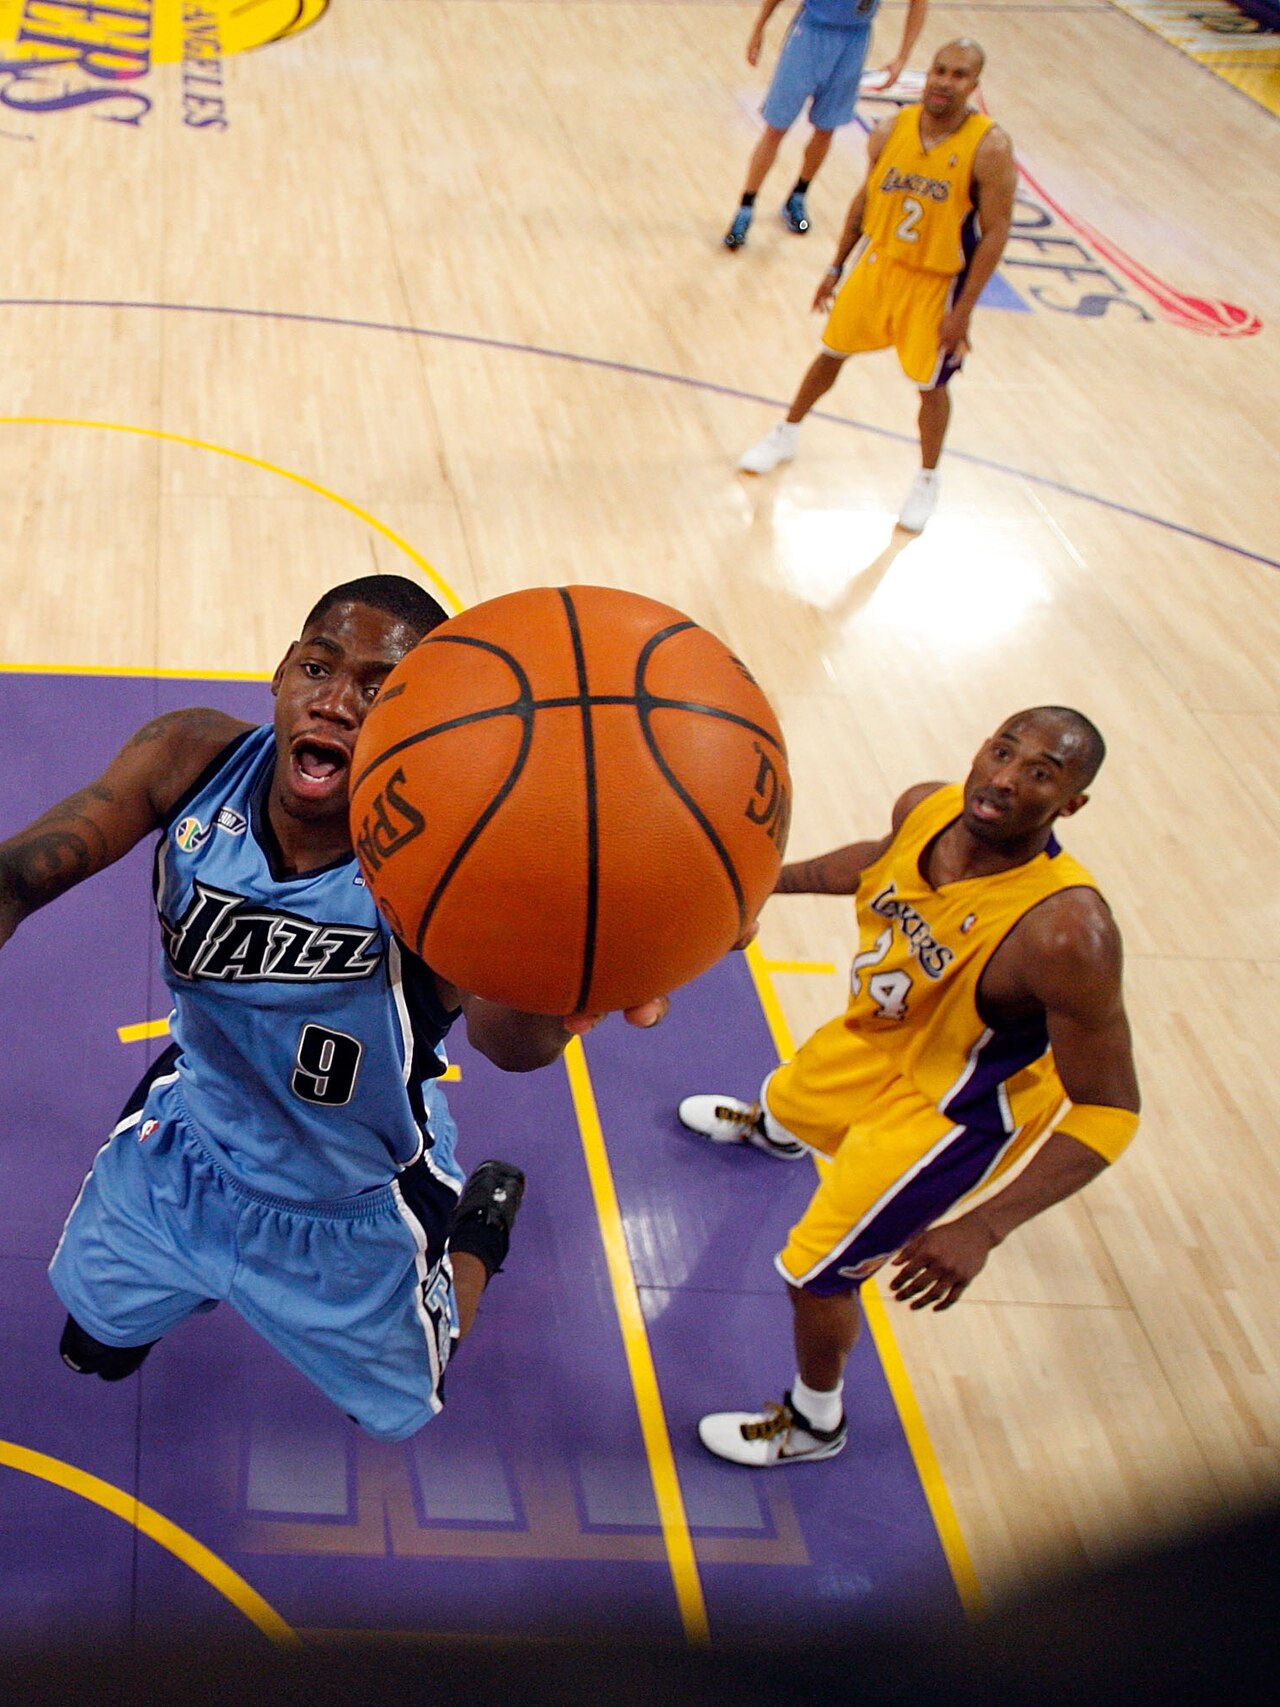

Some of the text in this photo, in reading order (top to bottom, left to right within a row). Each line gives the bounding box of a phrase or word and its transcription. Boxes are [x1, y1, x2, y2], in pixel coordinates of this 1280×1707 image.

[895, 195, 925, 243] 2
[160, 881, 384, 984] JAZZ
[850, 925, 914, 1022] 24
[870, 881, 956, 980] LAKERS
[291, 1022, 363, 1106] 9
